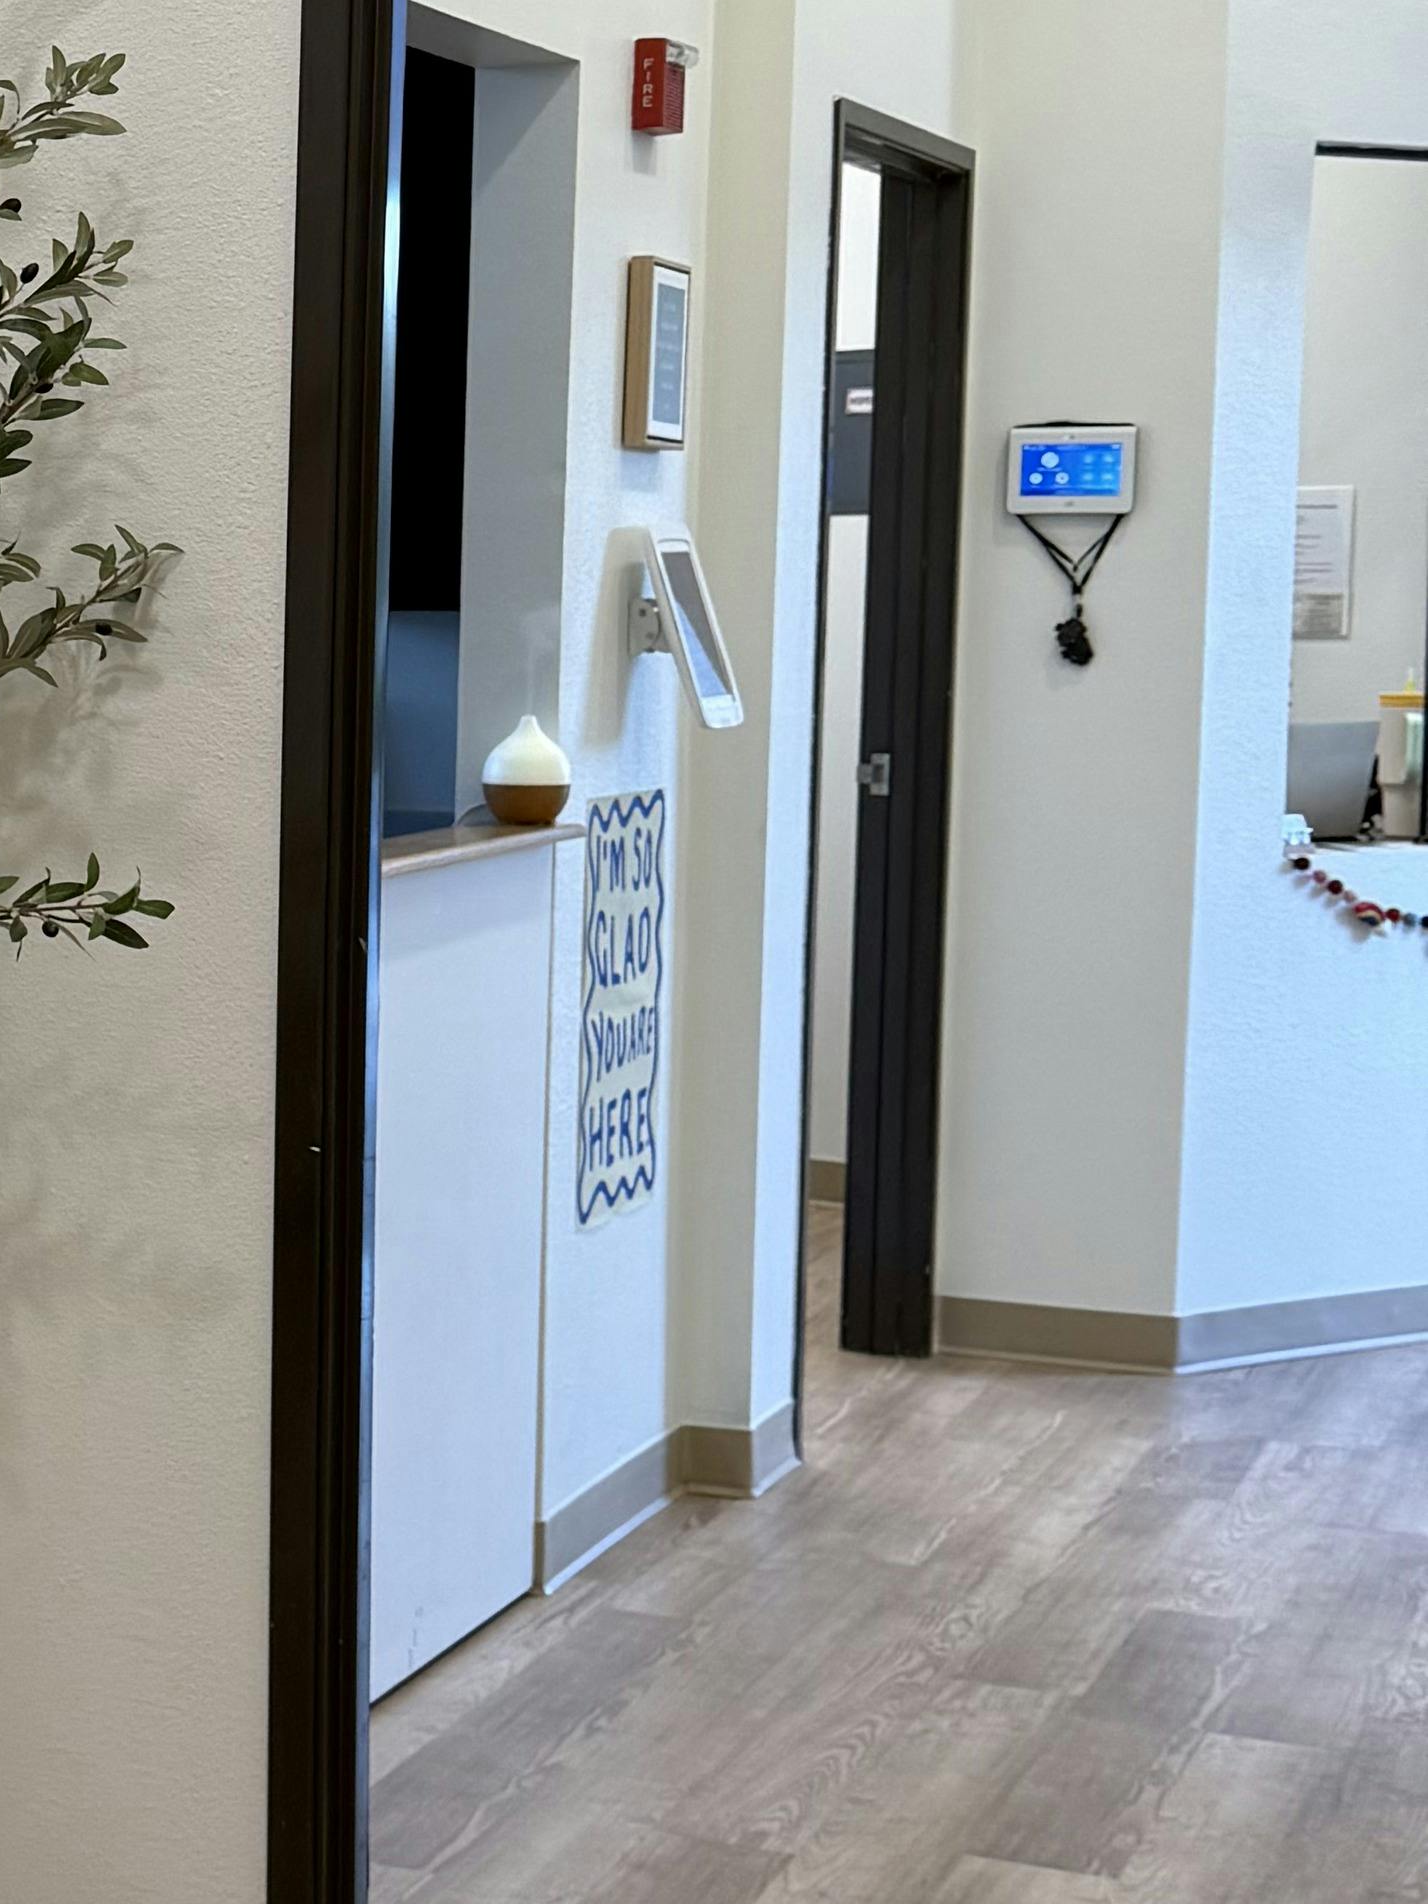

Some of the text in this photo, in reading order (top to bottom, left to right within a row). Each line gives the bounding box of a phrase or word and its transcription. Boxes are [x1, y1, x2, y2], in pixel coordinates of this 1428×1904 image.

[642, 57, 654, 108] FIRE
[594, 826, 653, 892] I'M SO
[595, 906, 651, 989] GLAD
[588, 1087, 648, 1173] HERE
